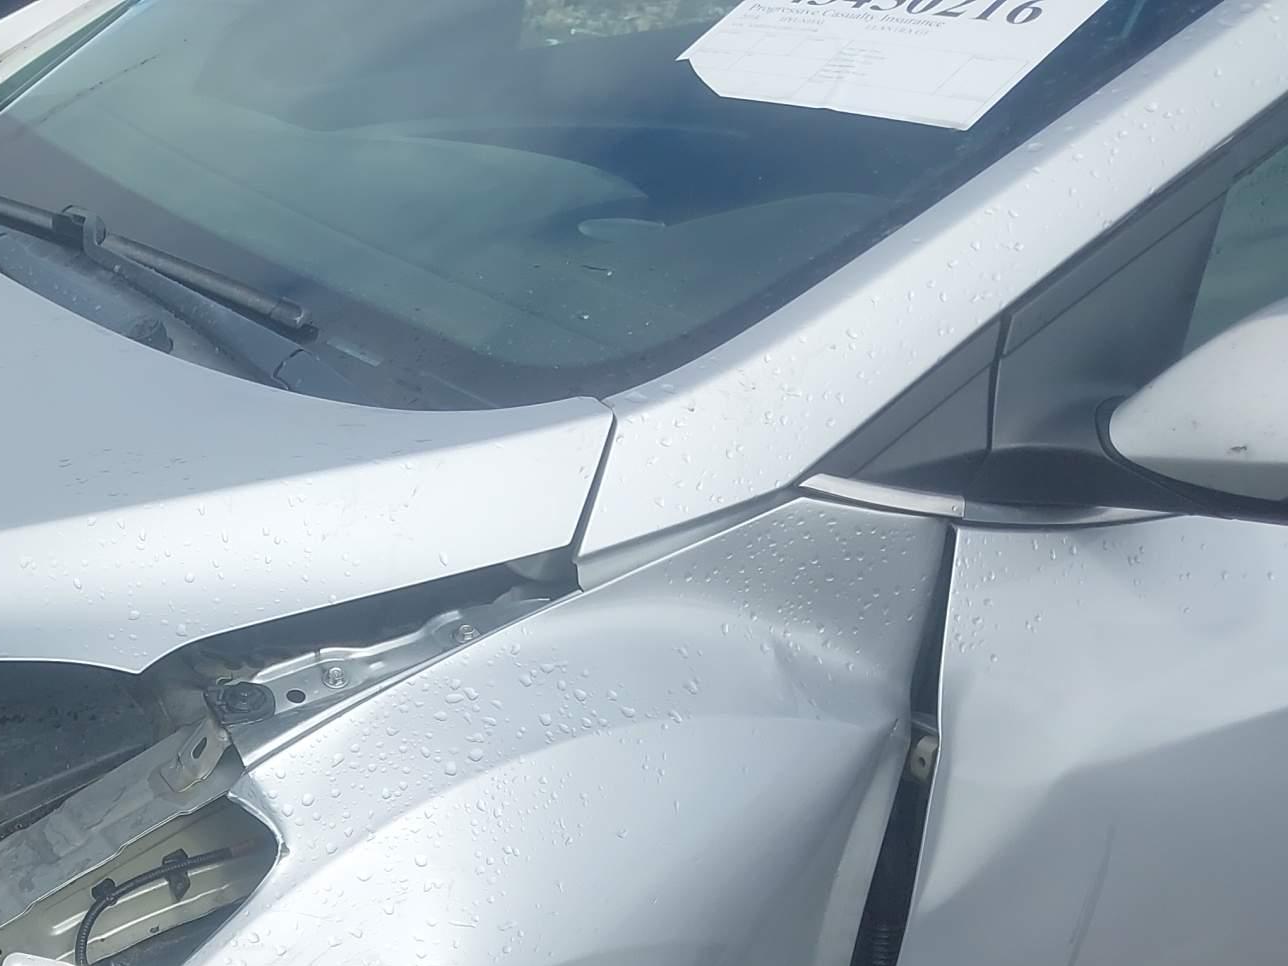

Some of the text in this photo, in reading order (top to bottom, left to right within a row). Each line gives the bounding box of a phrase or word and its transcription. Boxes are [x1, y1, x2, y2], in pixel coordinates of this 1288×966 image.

[749, 3, 820, 17] Progressive
[822, 9, 874, 21] Casualty
[881, 15, 945, 27] Insurance
